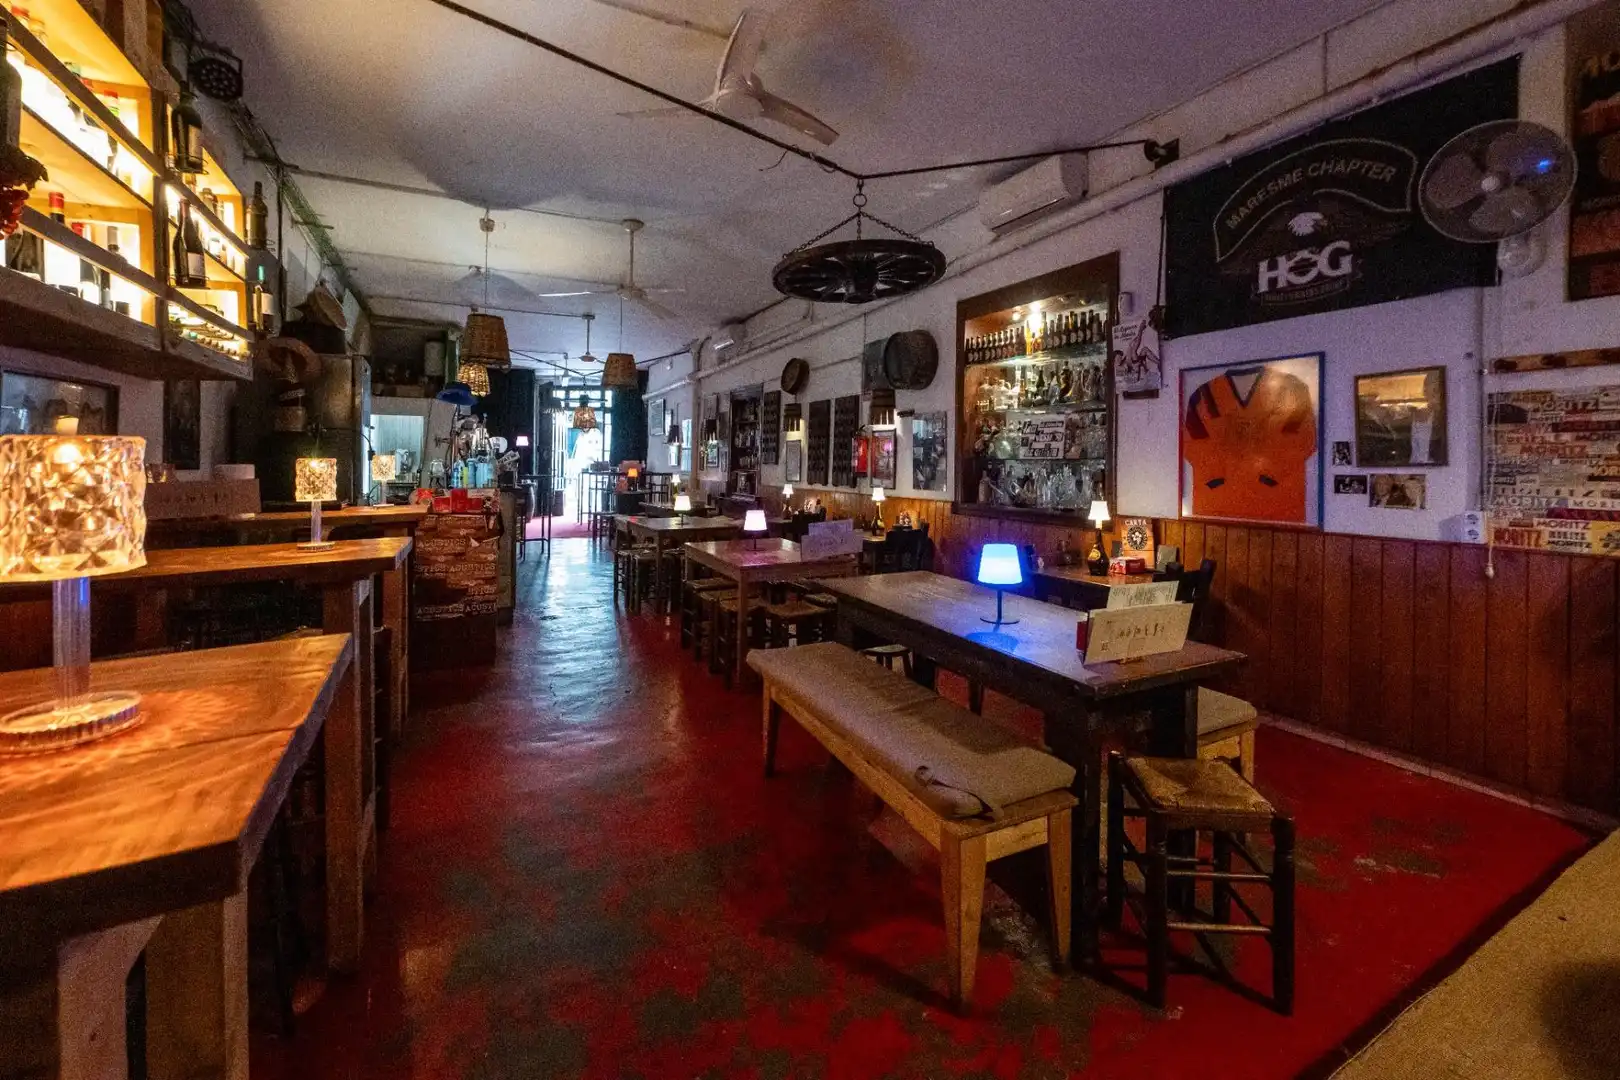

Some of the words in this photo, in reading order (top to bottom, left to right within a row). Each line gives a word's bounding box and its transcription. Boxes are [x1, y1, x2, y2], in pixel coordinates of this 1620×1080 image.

[1225, 167, 1304, 229] MARESME
[1308, 158, 1397, 183] CHAPTER
[1257, 240, 1354, 293] HOG
[1520, 445, 1587, 456] MORITZ
[1495, 497, 1561, 508] MORITZ
[1537, 519, 1592, 530] MORITZ
[1547, 540, 1592, 548] MORITZ
